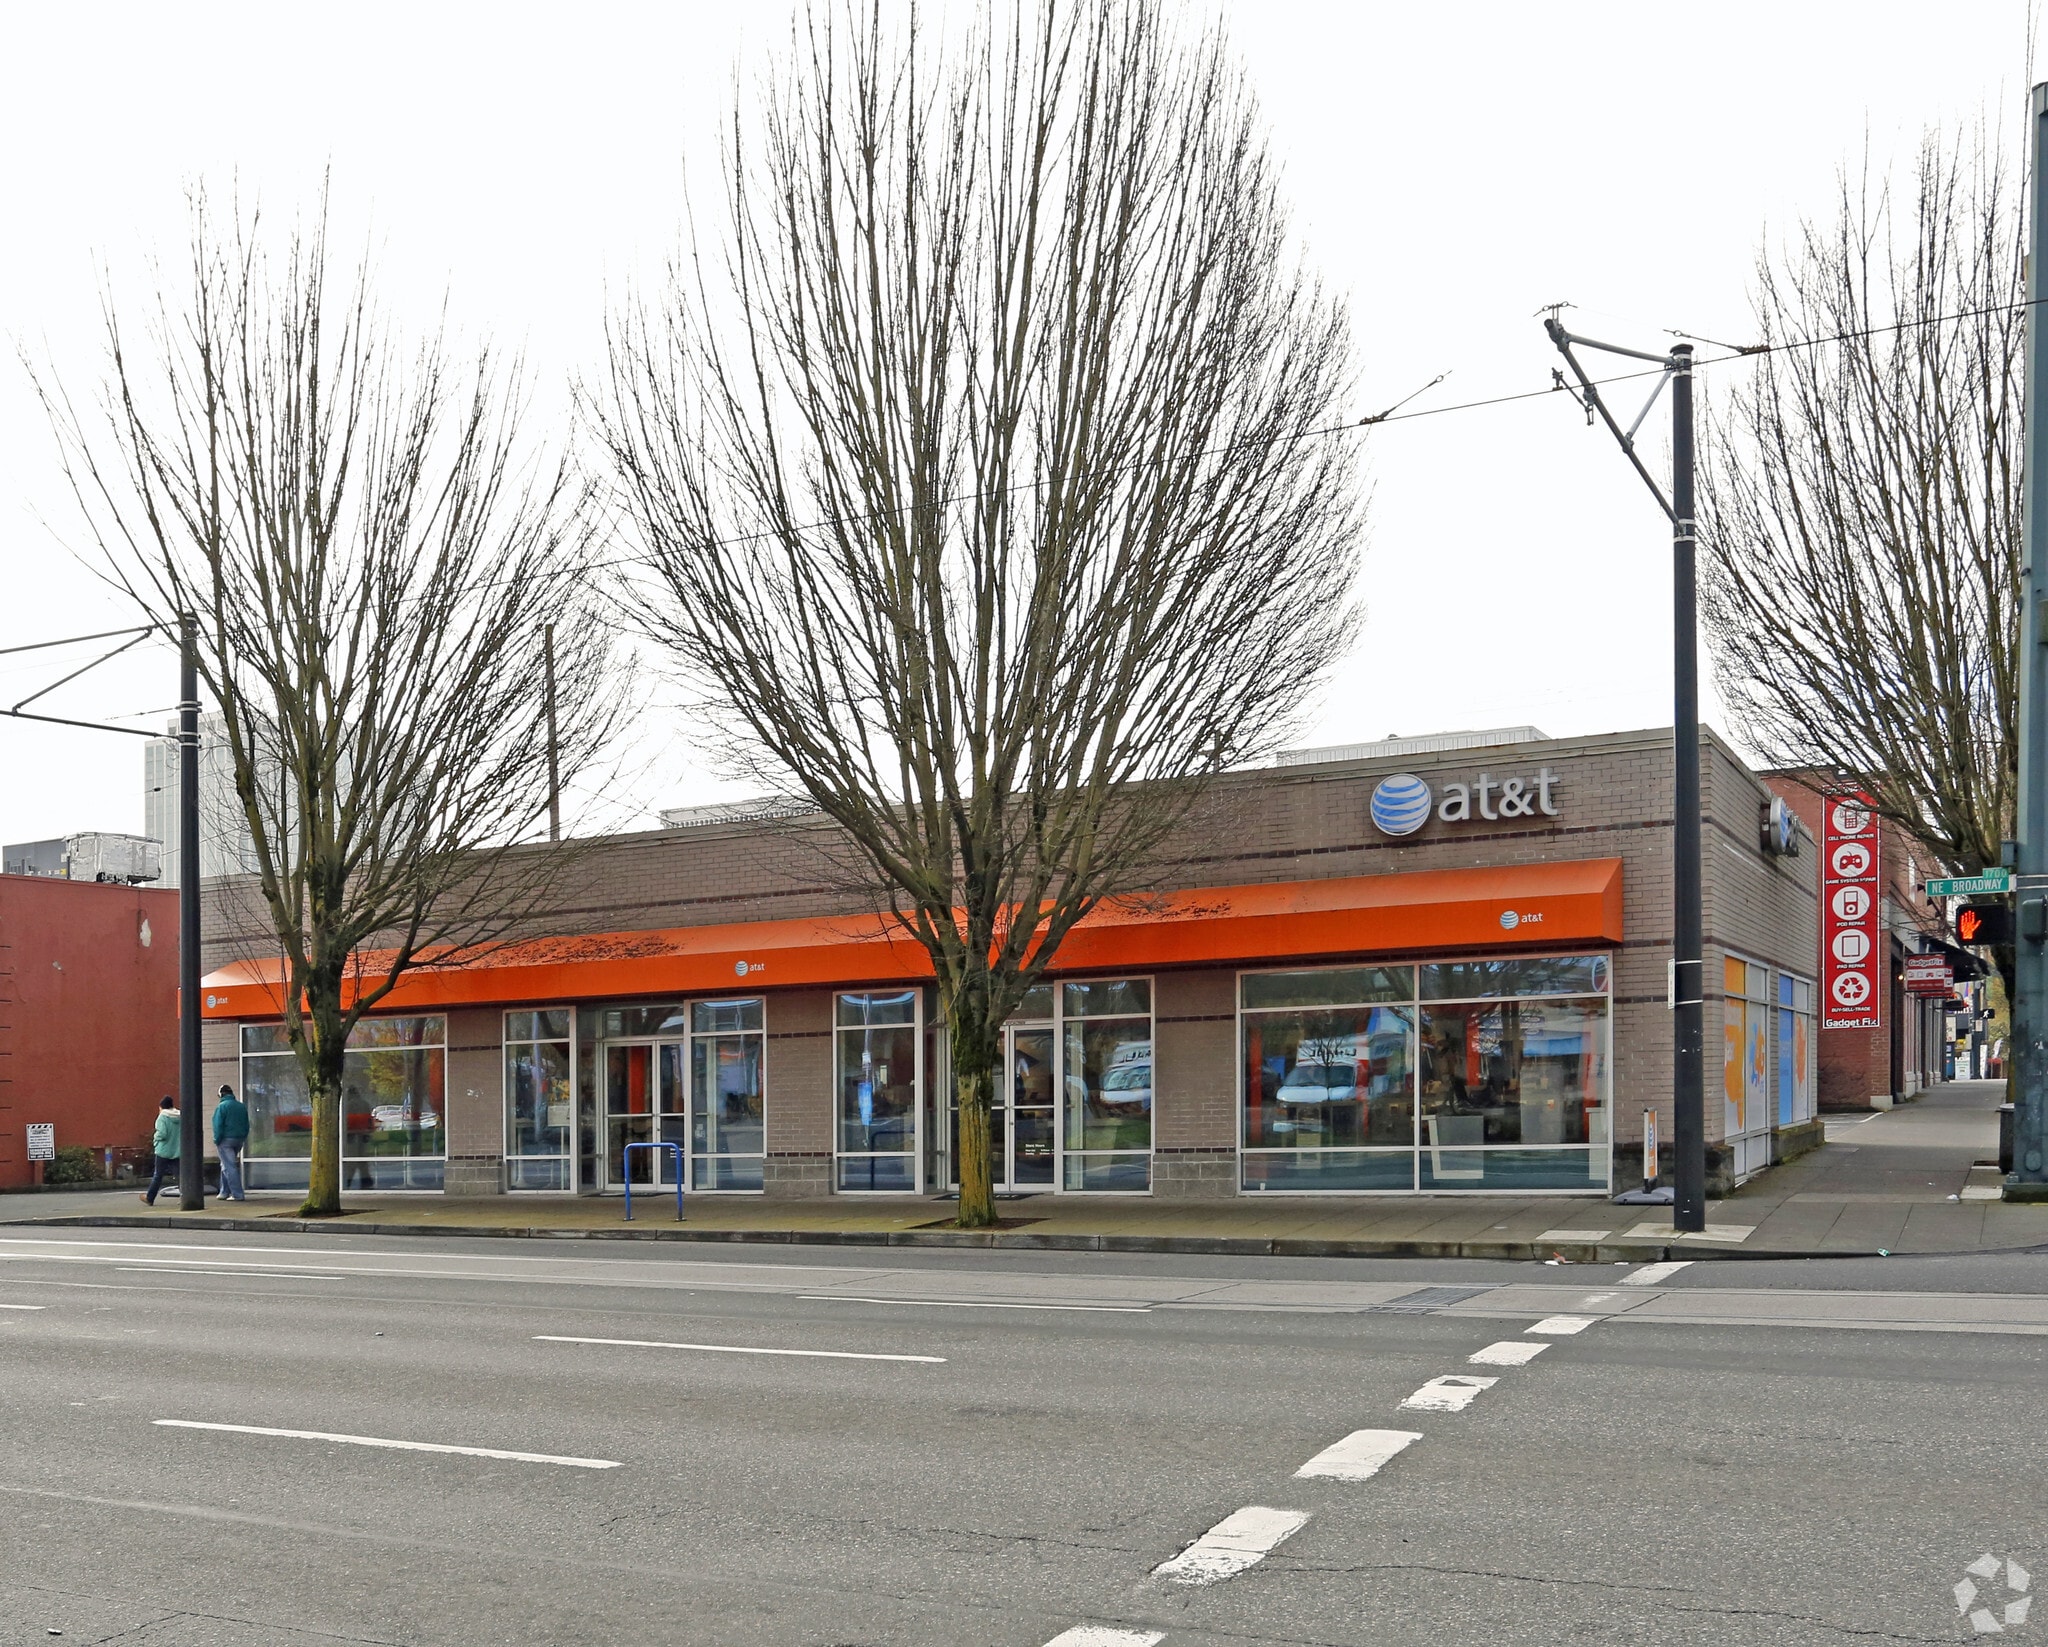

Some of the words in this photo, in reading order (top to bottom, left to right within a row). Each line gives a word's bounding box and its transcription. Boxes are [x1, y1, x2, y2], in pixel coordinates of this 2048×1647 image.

[1438, 768, 1560, 822] at&t
[1985, 869, 2007, 878] 1700
[1932, 882, 1944, 894] NE
[1952, 878, 2003, 892] BROADWAY
[1521, 912, 1543, 923] at&t
[749, 963, 765, 971] at&t
[1826, 1018, 1860, 1027] Gadget
[1862, 1017, 1877, 1026] Fix
